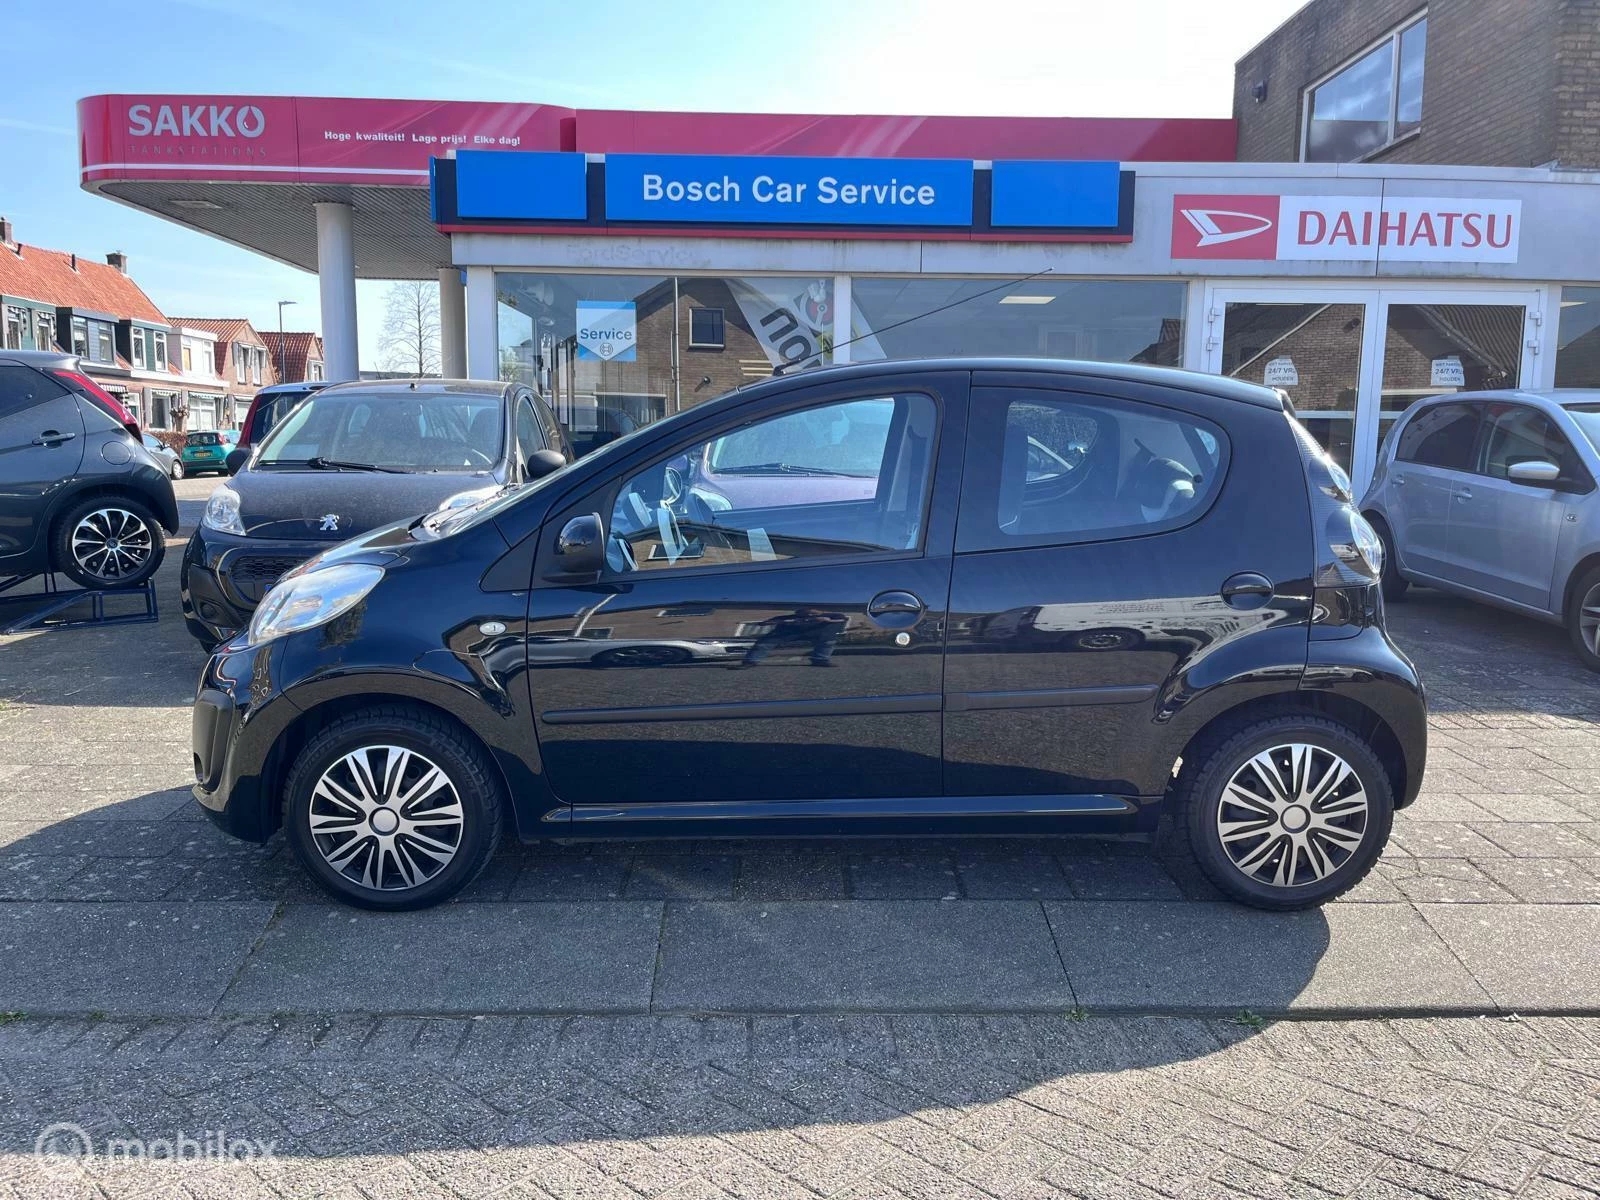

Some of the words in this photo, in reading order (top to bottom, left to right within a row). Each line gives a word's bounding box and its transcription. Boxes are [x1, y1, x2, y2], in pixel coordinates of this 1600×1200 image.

[128, 104, 265, 137] SAKKO
[324, 131, 351, 142] Hoge
[356, 132, 405, 142] kwaliteit!
[412, 133, 438, 144] Lage
[441, 134, 467, 145] prijs!
[474, 135, 496, 145] Elke
[499, 136, 521, 146] dag!
[129, 144, 267, 158] TANKSTATIONS
[643, 174, 740, 202] Bosch
[752, 175, 807, 203] Car
[817, 177, 935, 206] Service
[1297, 210, 1513, 249] DAIHATSU
[580, 328, 632, 340] Service
